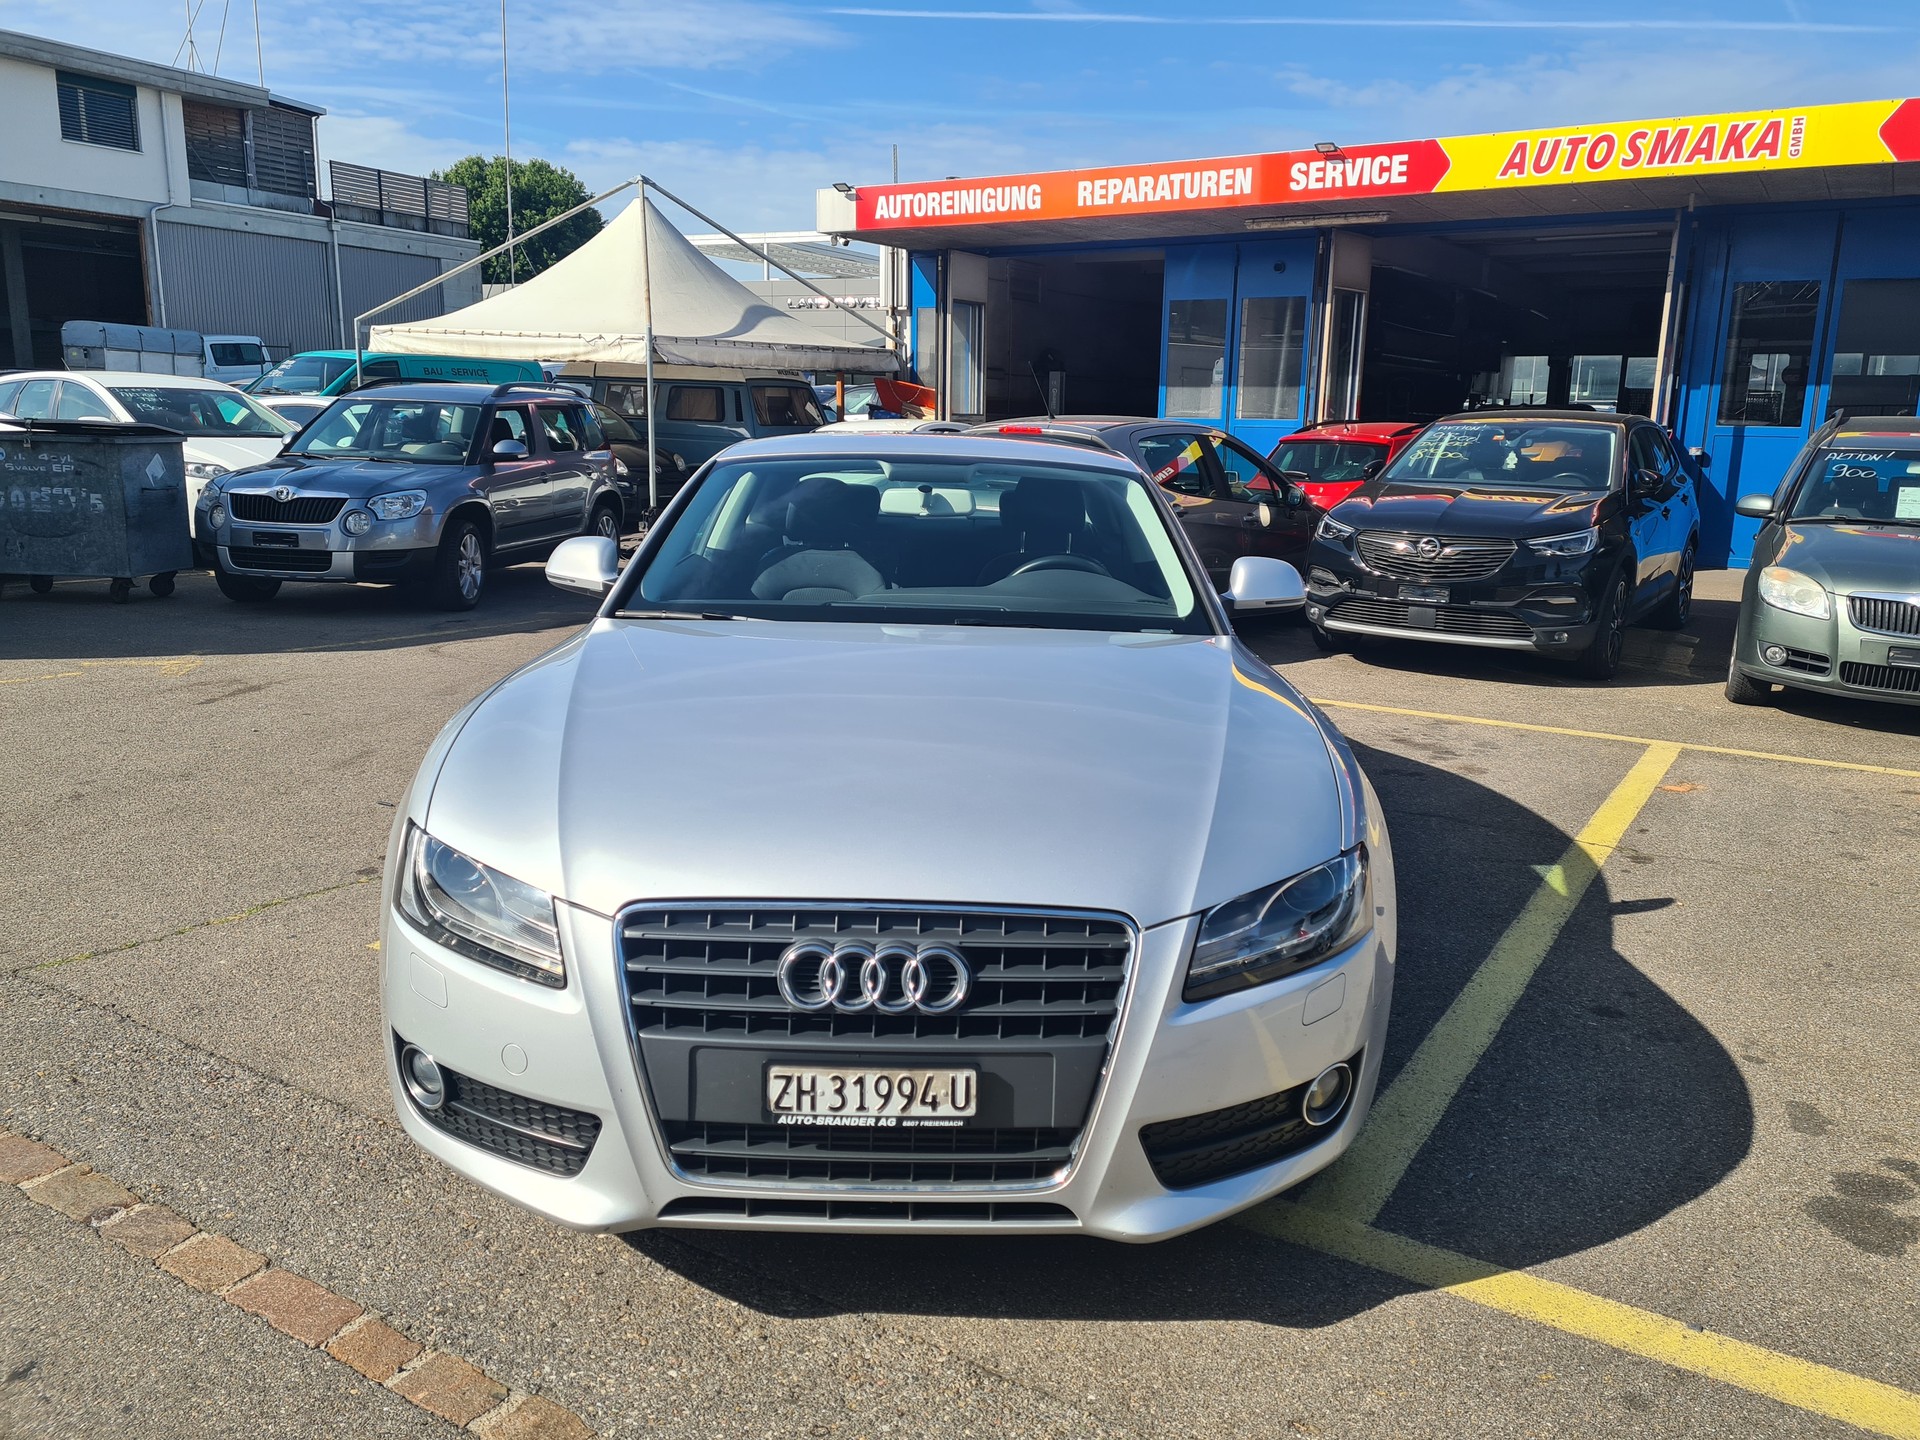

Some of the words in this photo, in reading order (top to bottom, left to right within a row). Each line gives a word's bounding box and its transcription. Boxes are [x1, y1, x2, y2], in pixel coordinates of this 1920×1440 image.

[1499, 133, 1616, 178] AUTO
[1620, 119, 1785, 169] SMAKA
[1789, 117, 1805, 157] GMBH
[874, 184, 1041, 220] AUTOREINIGUNG
[1077, 166, 1253, 207] REPARATUREN
[1289, 153, 1408, 191] SERVICE
[787, 296, 830, 309] LAND
[834, 296, 881, 309] ROVE
[423, 367, 443, 376] BAU
[451, 367, 488, 377] SERVICE
[772, 1074, 817, 1112] ZH
[827, 1074, 940, 1113] 31994
[949, 1074, 972, 1112] U
[778, 1116, 876, 1127] AUTO-BRANDER
[878, 1117, 897, 1127] AG
